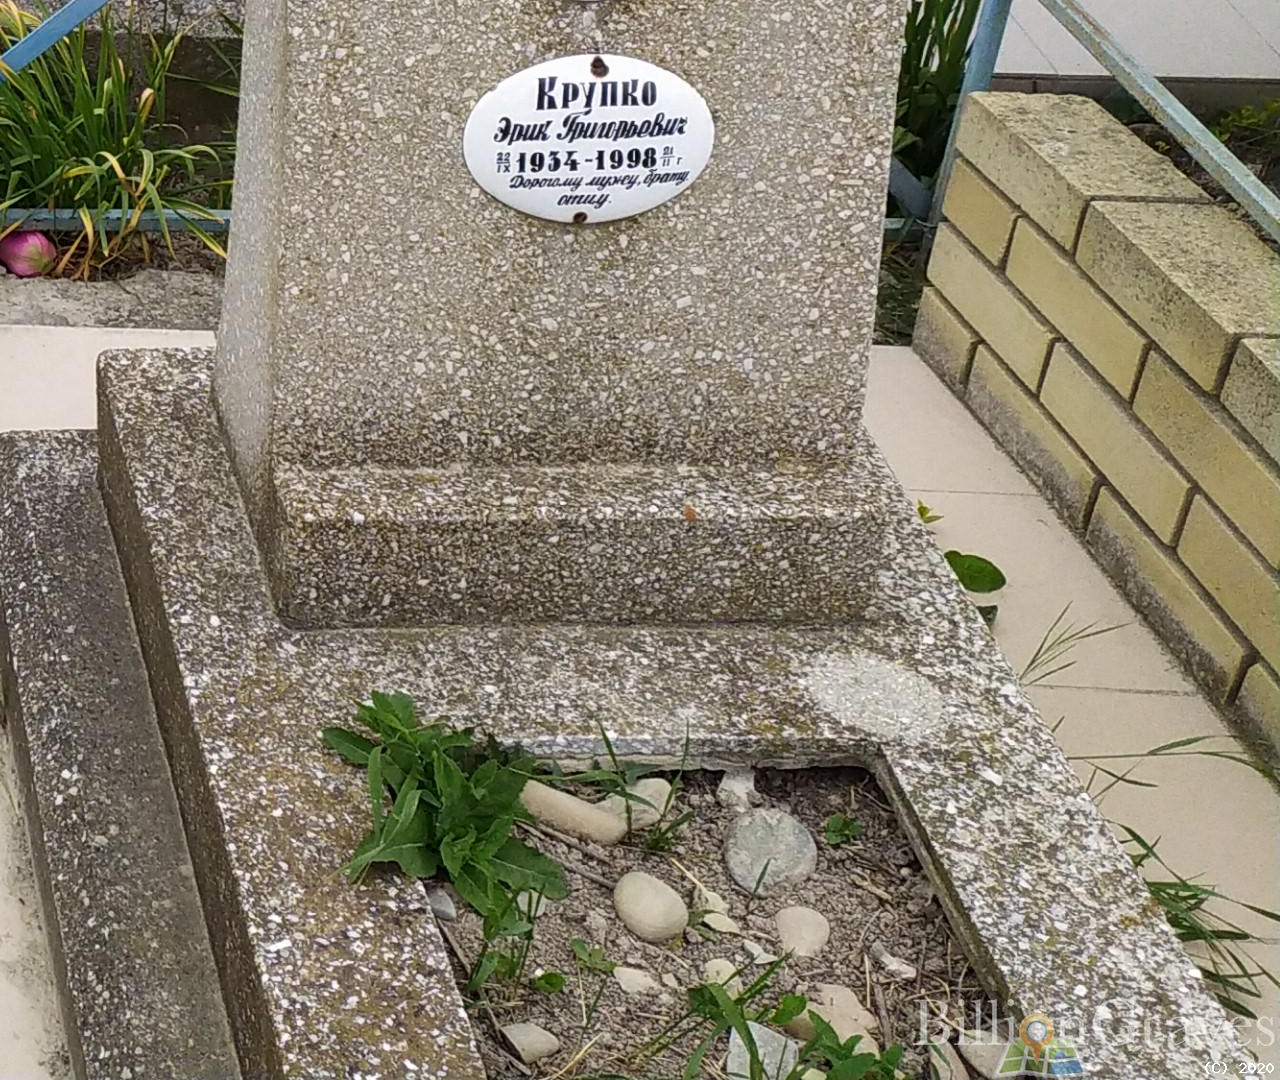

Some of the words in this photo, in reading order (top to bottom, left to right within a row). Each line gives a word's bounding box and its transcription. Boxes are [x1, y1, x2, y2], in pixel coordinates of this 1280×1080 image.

[493, 116, 553, 146] Эрик
[557, 108, 689, 143] Григорьевич
[509, 175, 584, 192] Дорогому
